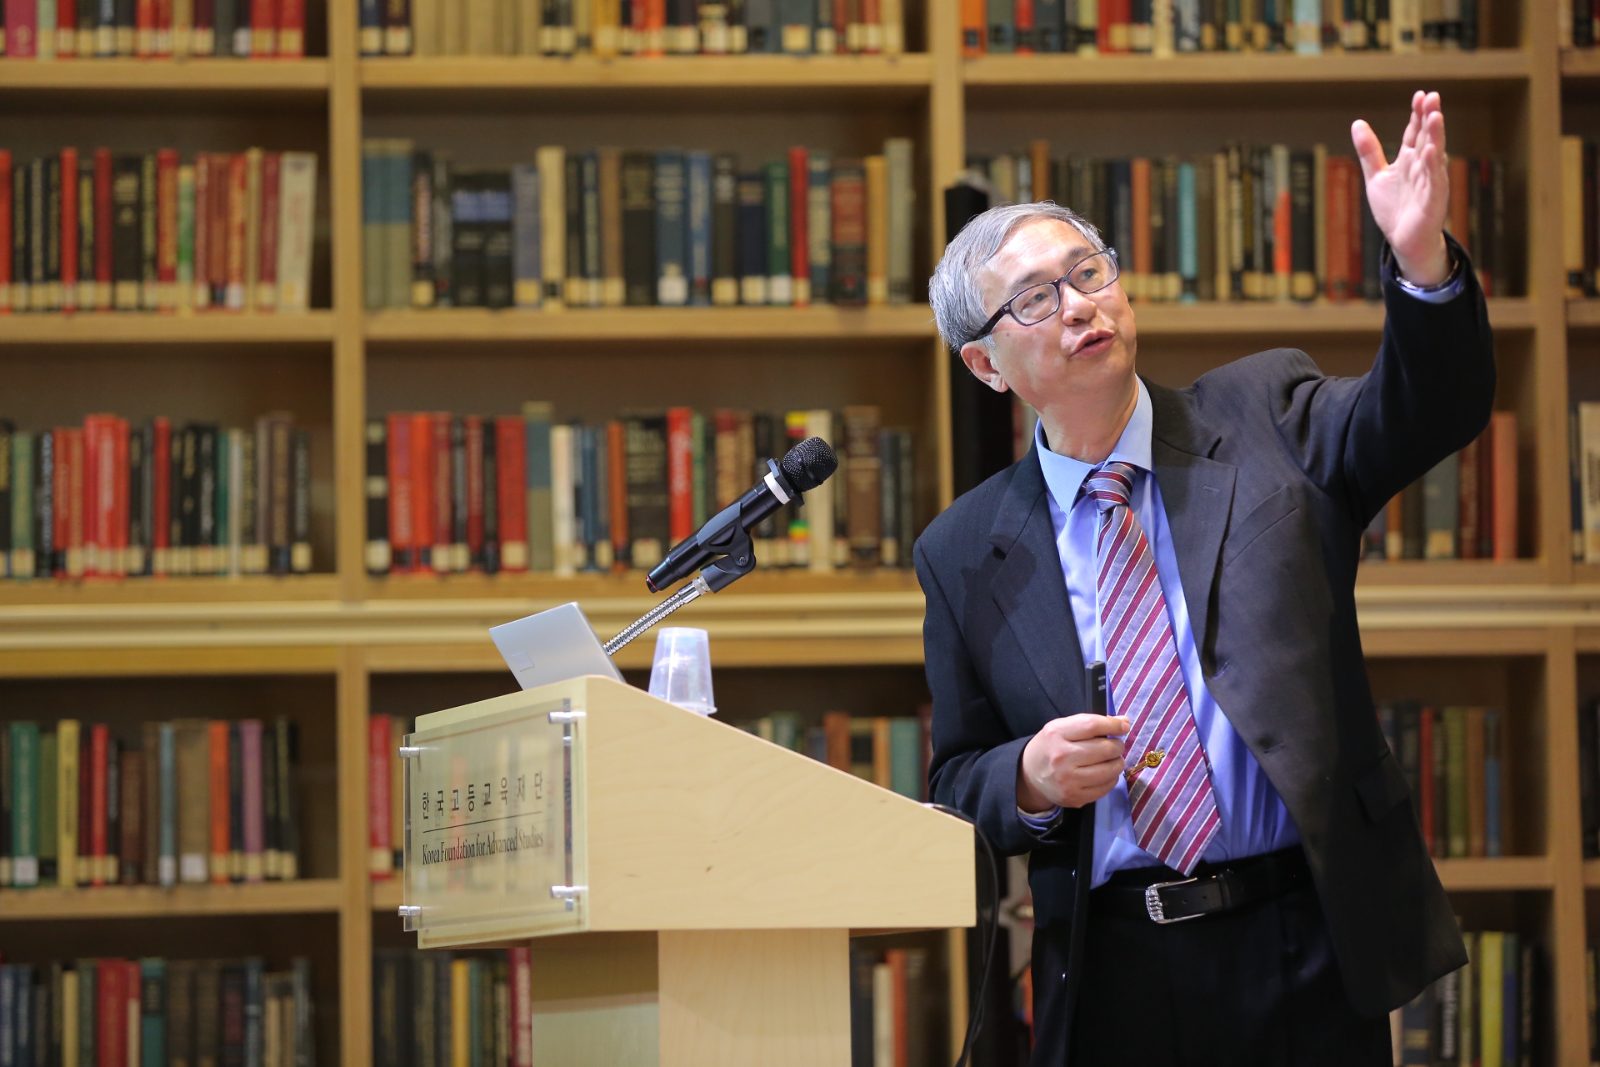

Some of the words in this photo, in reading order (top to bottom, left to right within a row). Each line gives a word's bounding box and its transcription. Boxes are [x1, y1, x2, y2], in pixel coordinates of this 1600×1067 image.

[422, 771, 543, 820] 한국고등교육재단
[422, 844, 440, 865] Korea
[441, 837, 475, 862] Foundation
[476, 833, 485, 857] for
[486, 827, 518, 855] Advanced
[519, 824, 544, 849] Studies
